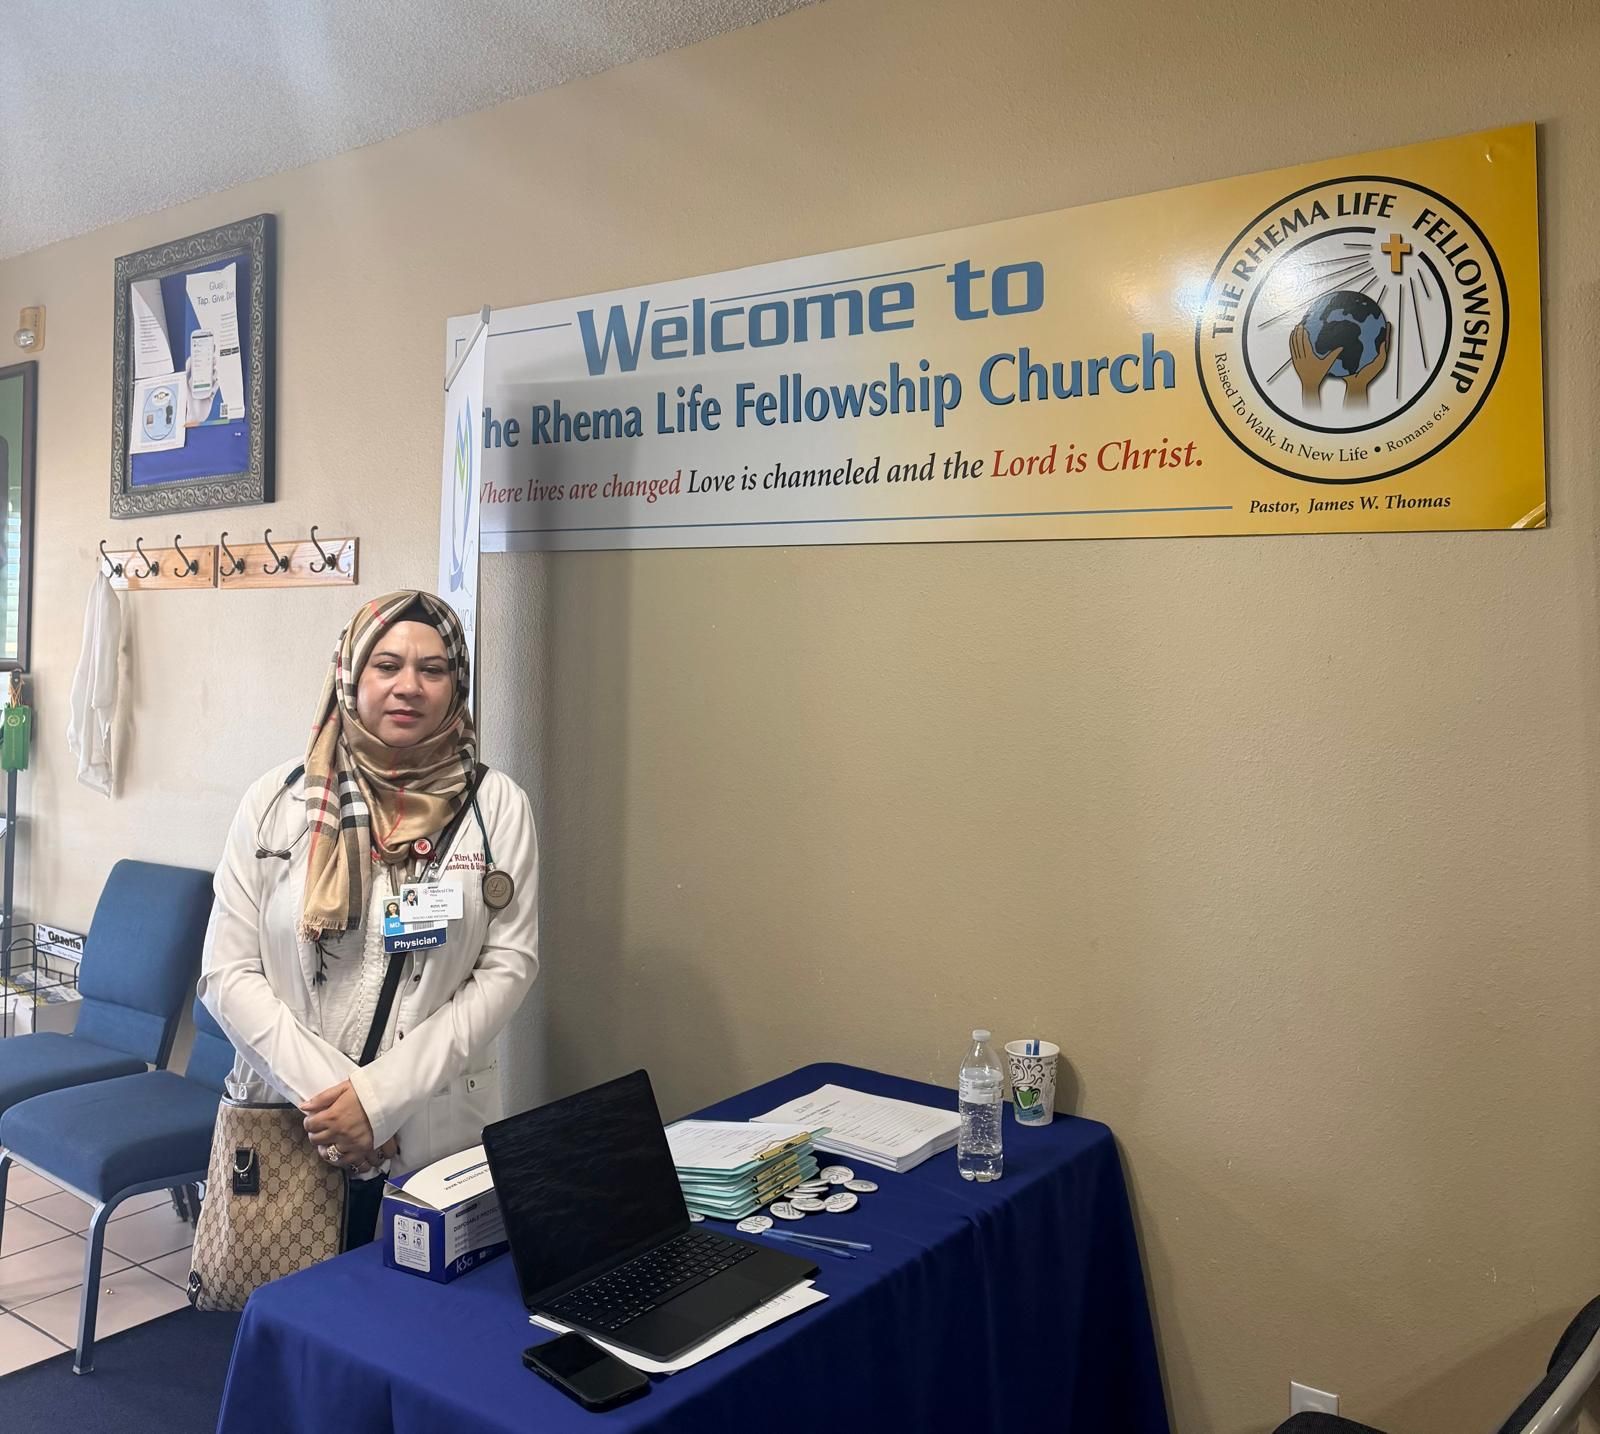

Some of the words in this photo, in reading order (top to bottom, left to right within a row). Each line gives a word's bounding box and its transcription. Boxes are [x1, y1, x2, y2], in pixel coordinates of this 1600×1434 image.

[576, 281, 915, 377] Welcome
[946, 259, 1045, 321] to
[1212, 282, 1244, 339] THE
[1232, 199, 1330, 283] RHEMA
[1337, 191, 1397, 219] LIFE
[1412, 208, 1491, 395] FELLOWSHIP
[481, 407, 521, 449] he
[531, 400, 644, 446] Rhema
[656, 383, 722, 435] Life
[735, 358, 962, 428] Fellowship
[978, 332, 1176, 406] Church
[1215, 351, 1239, 400] Raised
[1232, 396, 1247, 417] To
[1245, 412, 1279, 448] Walk,
[1280, 436, 1295, 454] In
[1297, 443, 1335, 463] New
[1339, 448, 1369, 463] Life
[1385, 422, 1435, 453] Romans
[1432, 402, 1451, 422] 6:4
[527, 478, 564, 503] lives
[568, 481, 599, 500] are
[602, 469, 683, 504] changed
[687, 469, 735, 494] Love
[741, 464, 758, 491] is
[762, 456, 881, 490] channeled
[886, 452, 936, 484] and
[943, 450, 984, 480] the
[990, 444, 1057, 478] Lord
[1065, 444, 1088, 474] is
[1097, 437, 1204, 472] Christ.
[1249, 499, 1300, 514] Pastor,
[1307, 497, 1355, 514] James
[1360, 496, 1379, 510] W.
[1385, 494, 1452, 510] Thomas
[394, 936, 437, 949] Physician
